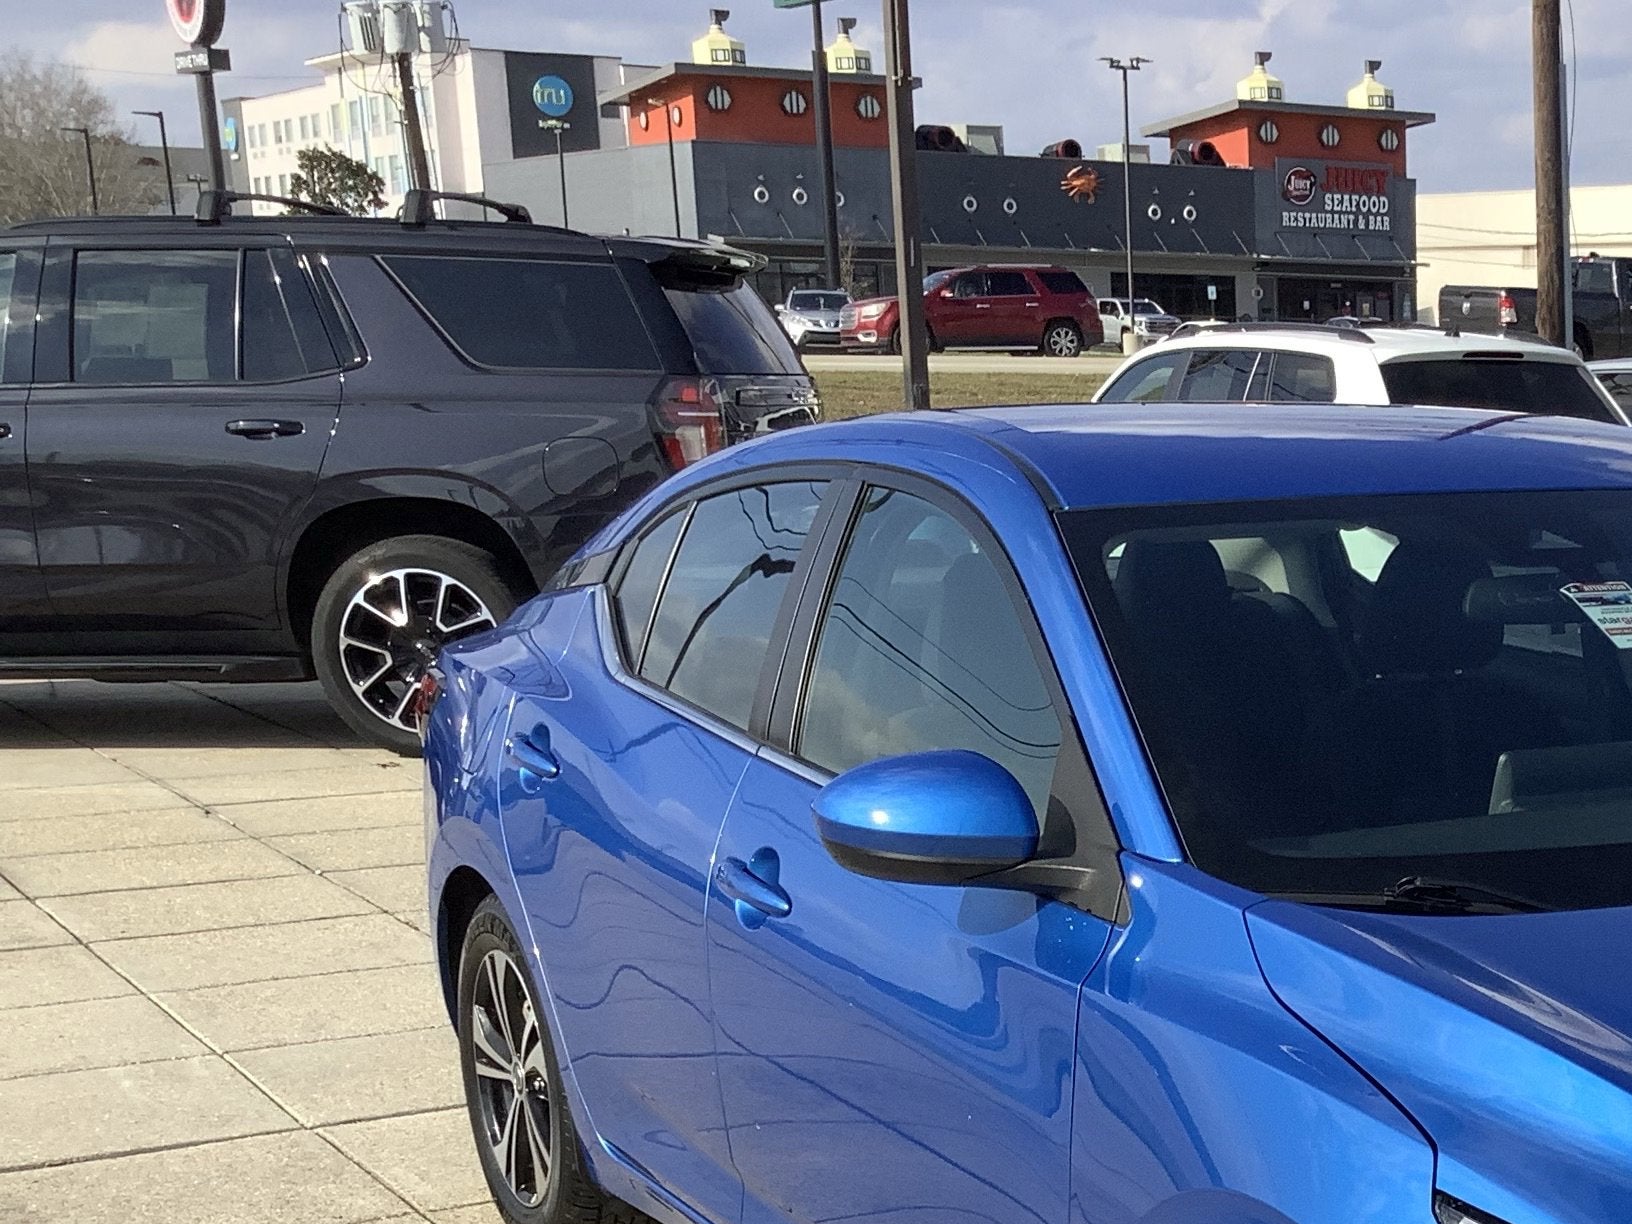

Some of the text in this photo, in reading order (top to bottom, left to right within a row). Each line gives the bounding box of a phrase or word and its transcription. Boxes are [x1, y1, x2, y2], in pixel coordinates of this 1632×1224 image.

[1322, 166, 1388, 196] JUICY
[1324, 193, 1389, 213] SEAFOOD
[1282, 212, 1391, 231] RESTAURANT & BAR
